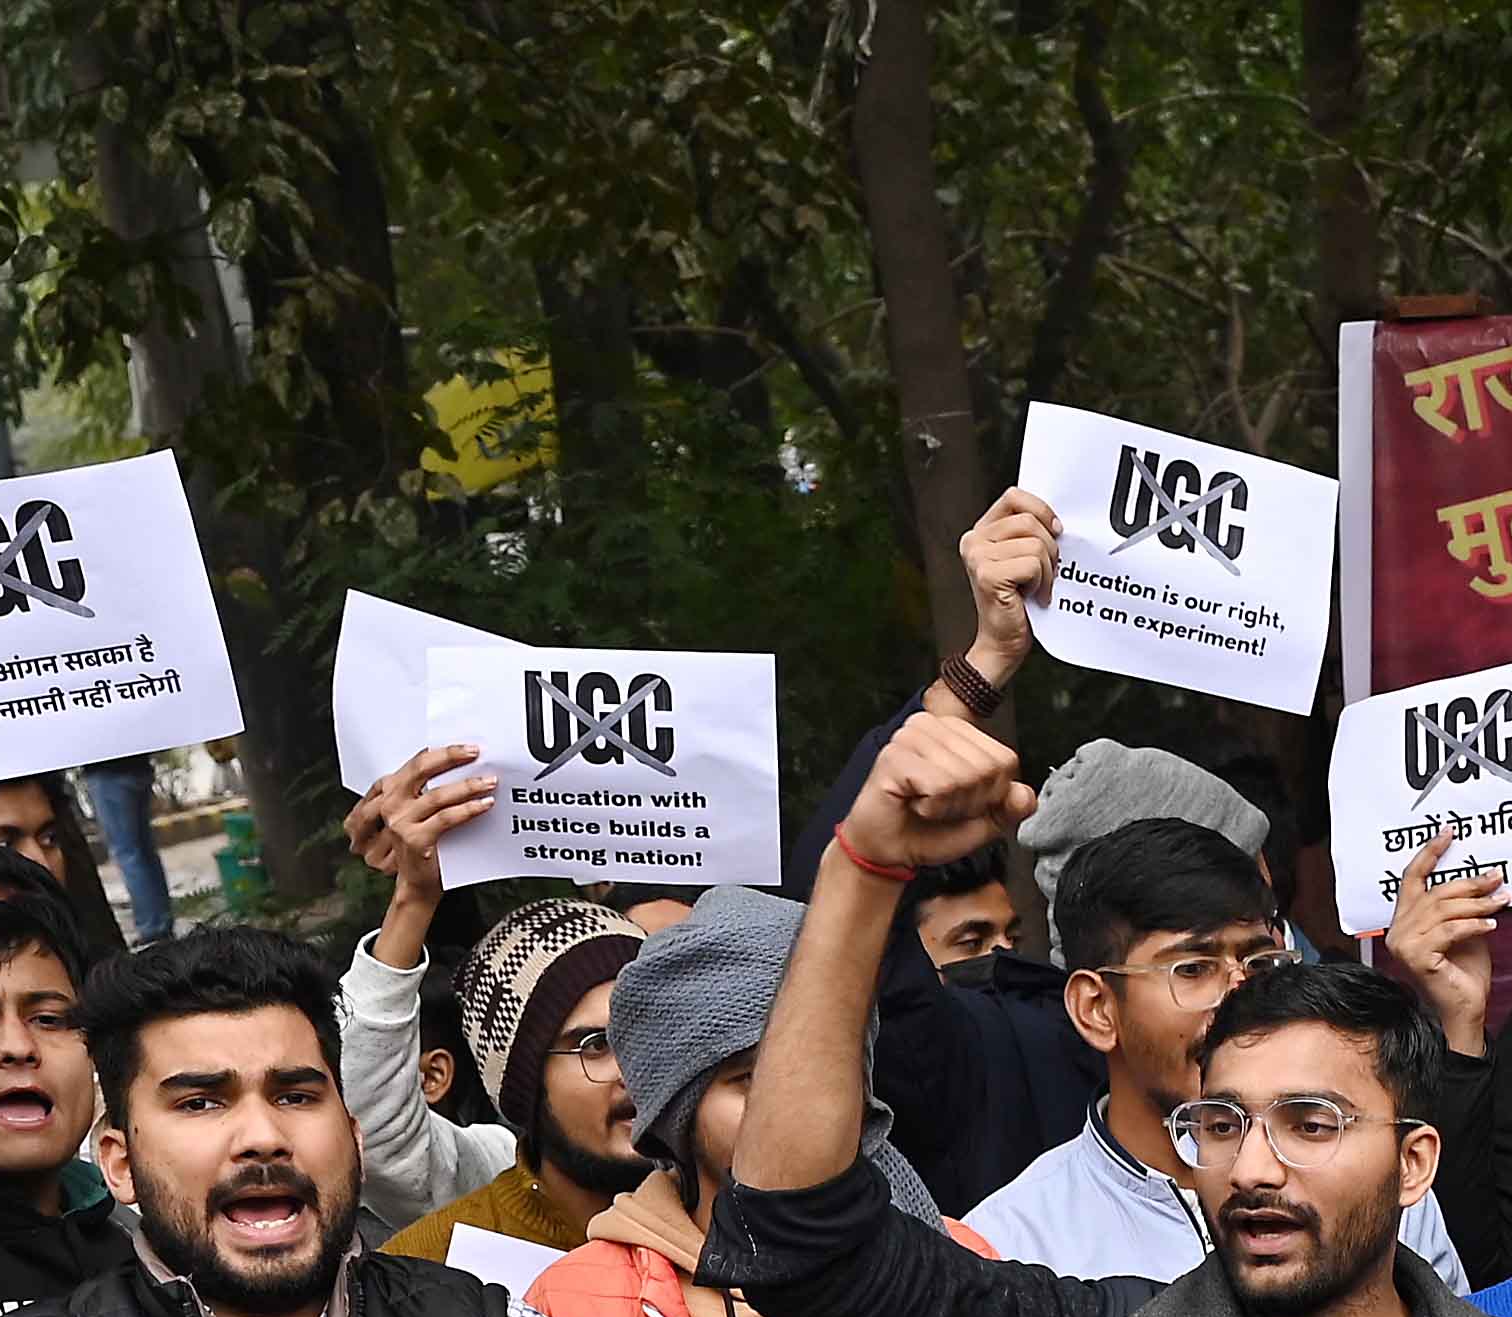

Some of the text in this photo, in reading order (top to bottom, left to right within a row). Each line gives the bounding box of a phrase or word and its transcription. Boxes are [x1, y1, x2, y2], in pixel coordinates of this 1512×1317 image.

[1110, 444, 1248, 560] UGC
[1059, 596, 1266, 657] not an experiment!
[68, 679, 113, 710] नहीं
[115, 669, 183, 702] चलेगी
[524, 670, 674, 765] UGC
[511, 788, 706, 809] Education with
[511, 813, 710, 839] justice builds a
[1382, 814, 1442, 852] छात्रों
[1447, 810, 1473, 841] के
[523, 844, 703, 867] strong nation!
